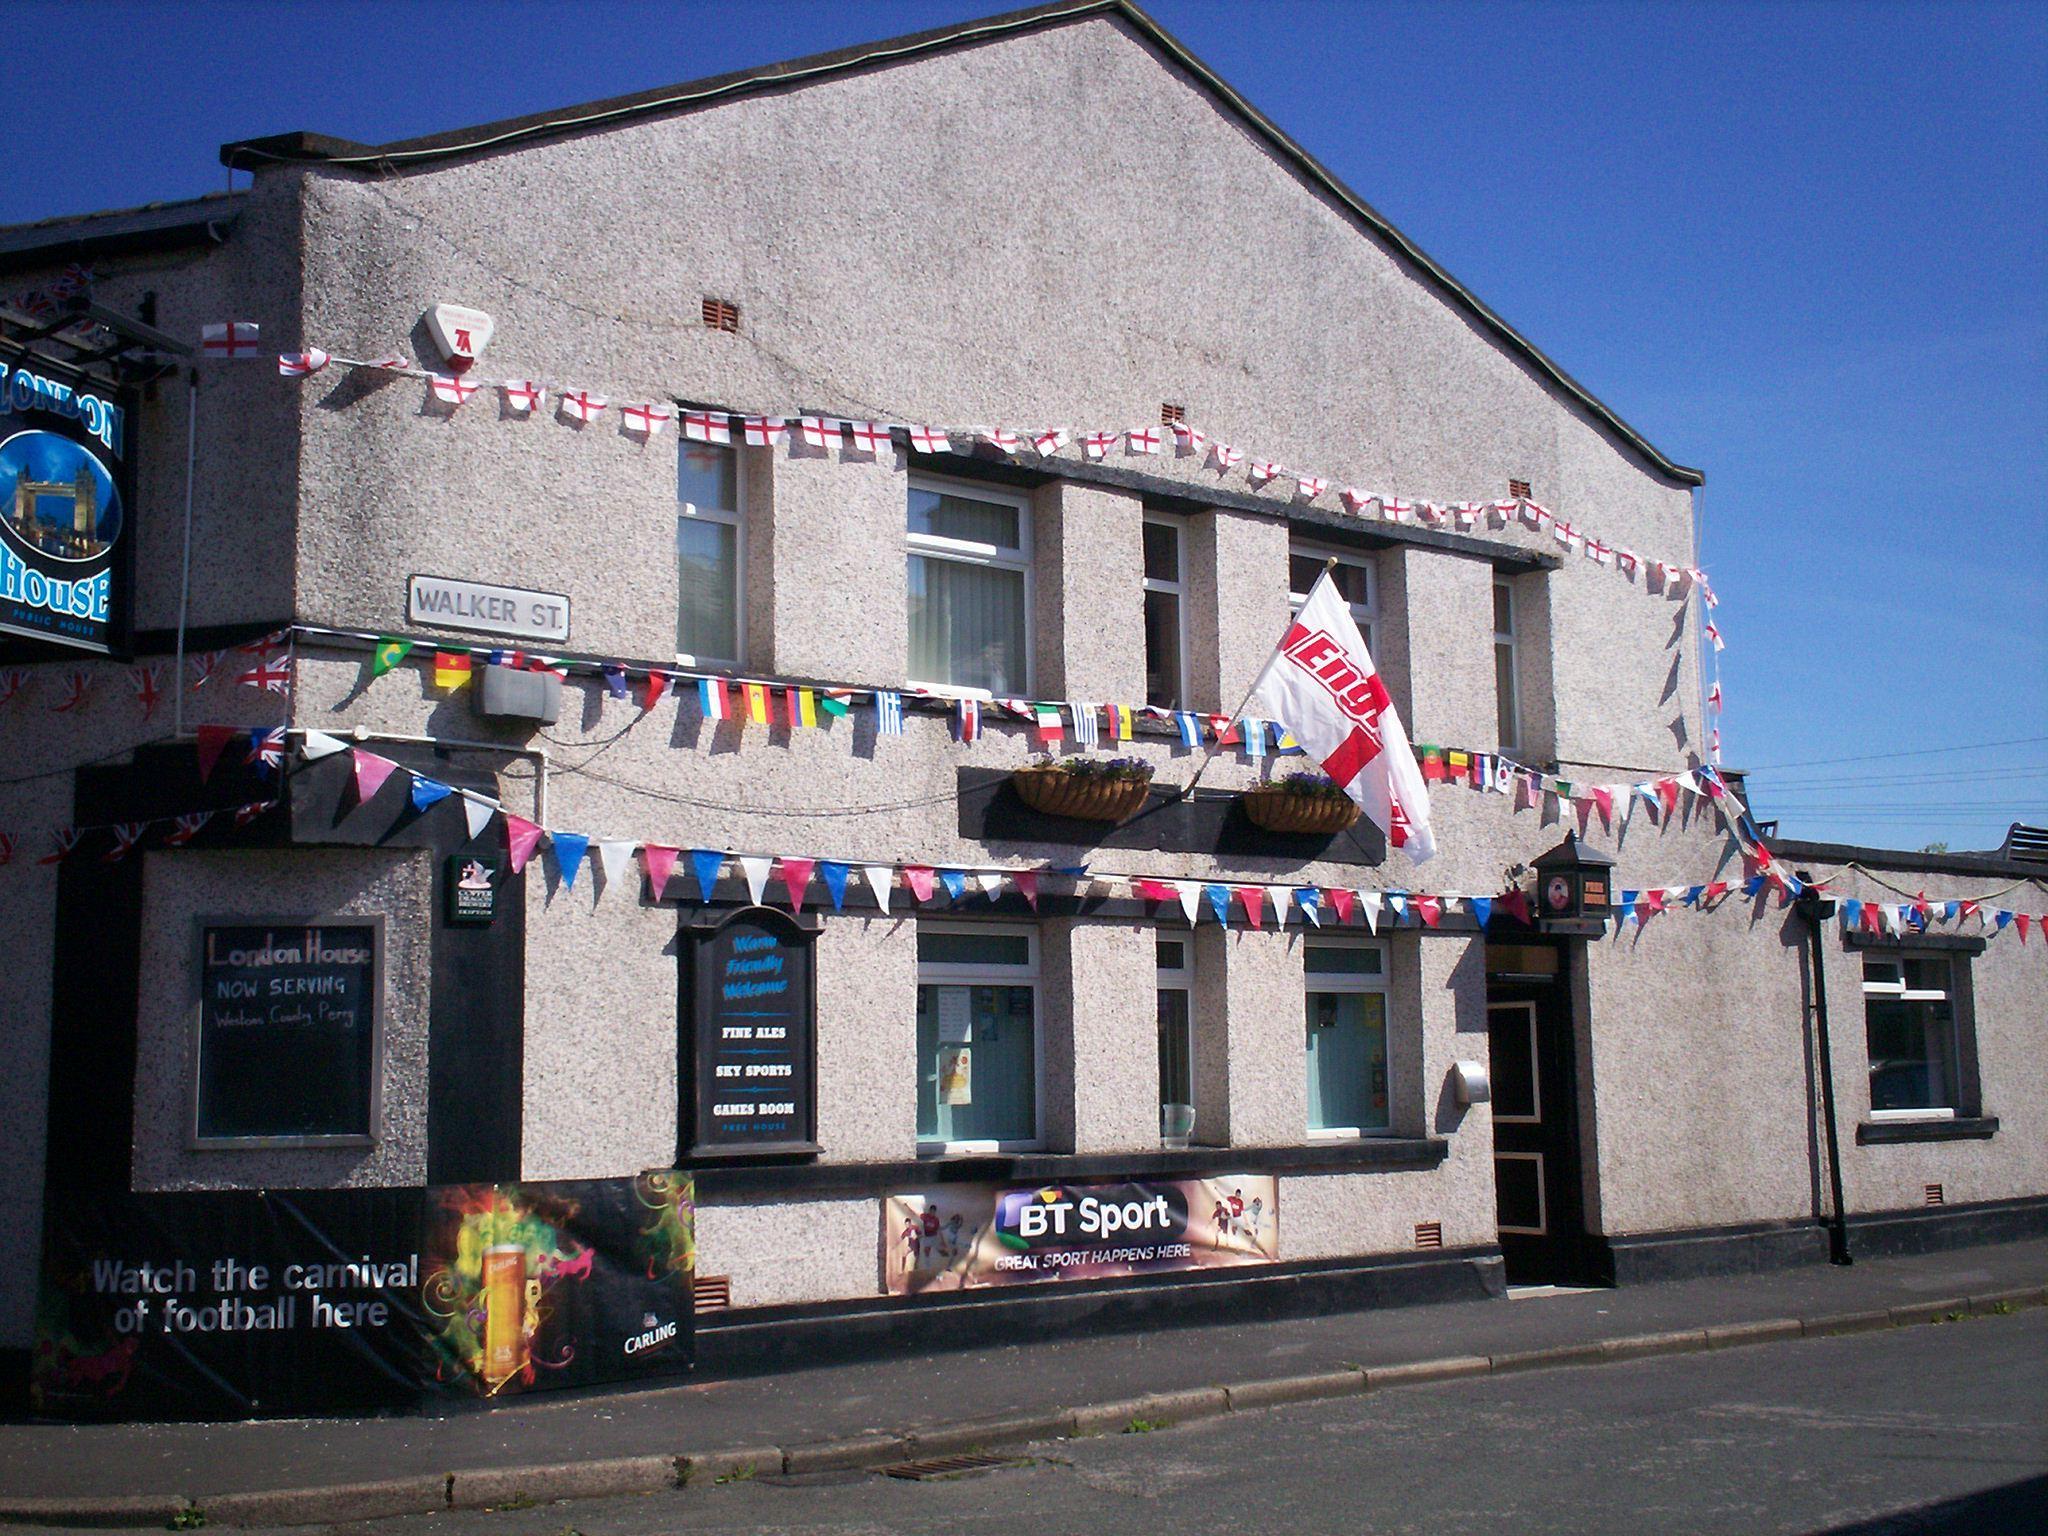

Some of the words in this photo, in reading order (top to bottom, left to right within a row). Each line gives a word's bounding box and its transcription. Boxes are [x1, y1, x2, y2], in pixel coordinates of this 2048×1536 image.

[416, 587, 517, 623] WALKER
[208, 932, 301, 968] London
[306, 929, 372, 965] House
[217, 980, 258, 999] NOW
[269, 976, 346, 996] SERVING
[722, 1027, 752, 1039] FINE
[755, 1027, 786, 1039] ALES
[715, 1065, 742, 1077] SKY
[745, 1064, 792, 1077] SPORTS
[713, 1104, 755, 1116] GAMES
[758, 1103, 795, 1115] ROOM
[1019, 1203, 1074, 1238] BT
[1078, 1194, 1171, 1240] Sport
[994, 1255, 1041, 1272] GREAT
[1042, 1252, 1089, 1269] SPORT
[1091, 1246, 1154, 1264] HAPPENS
[1156, 1243, 1192, 1258] HERE
[93, 1259, 196, 1294] Watch
[212, 1258, 269, 1292] the
[283, 1254, 418, 1289] carnival
[114, 1300, 149, 1333] of
[163, 1296, 296, 1333] football
[312, 1295, 389, 1328] here
[624, 1322, 677, 1354] CARLING
